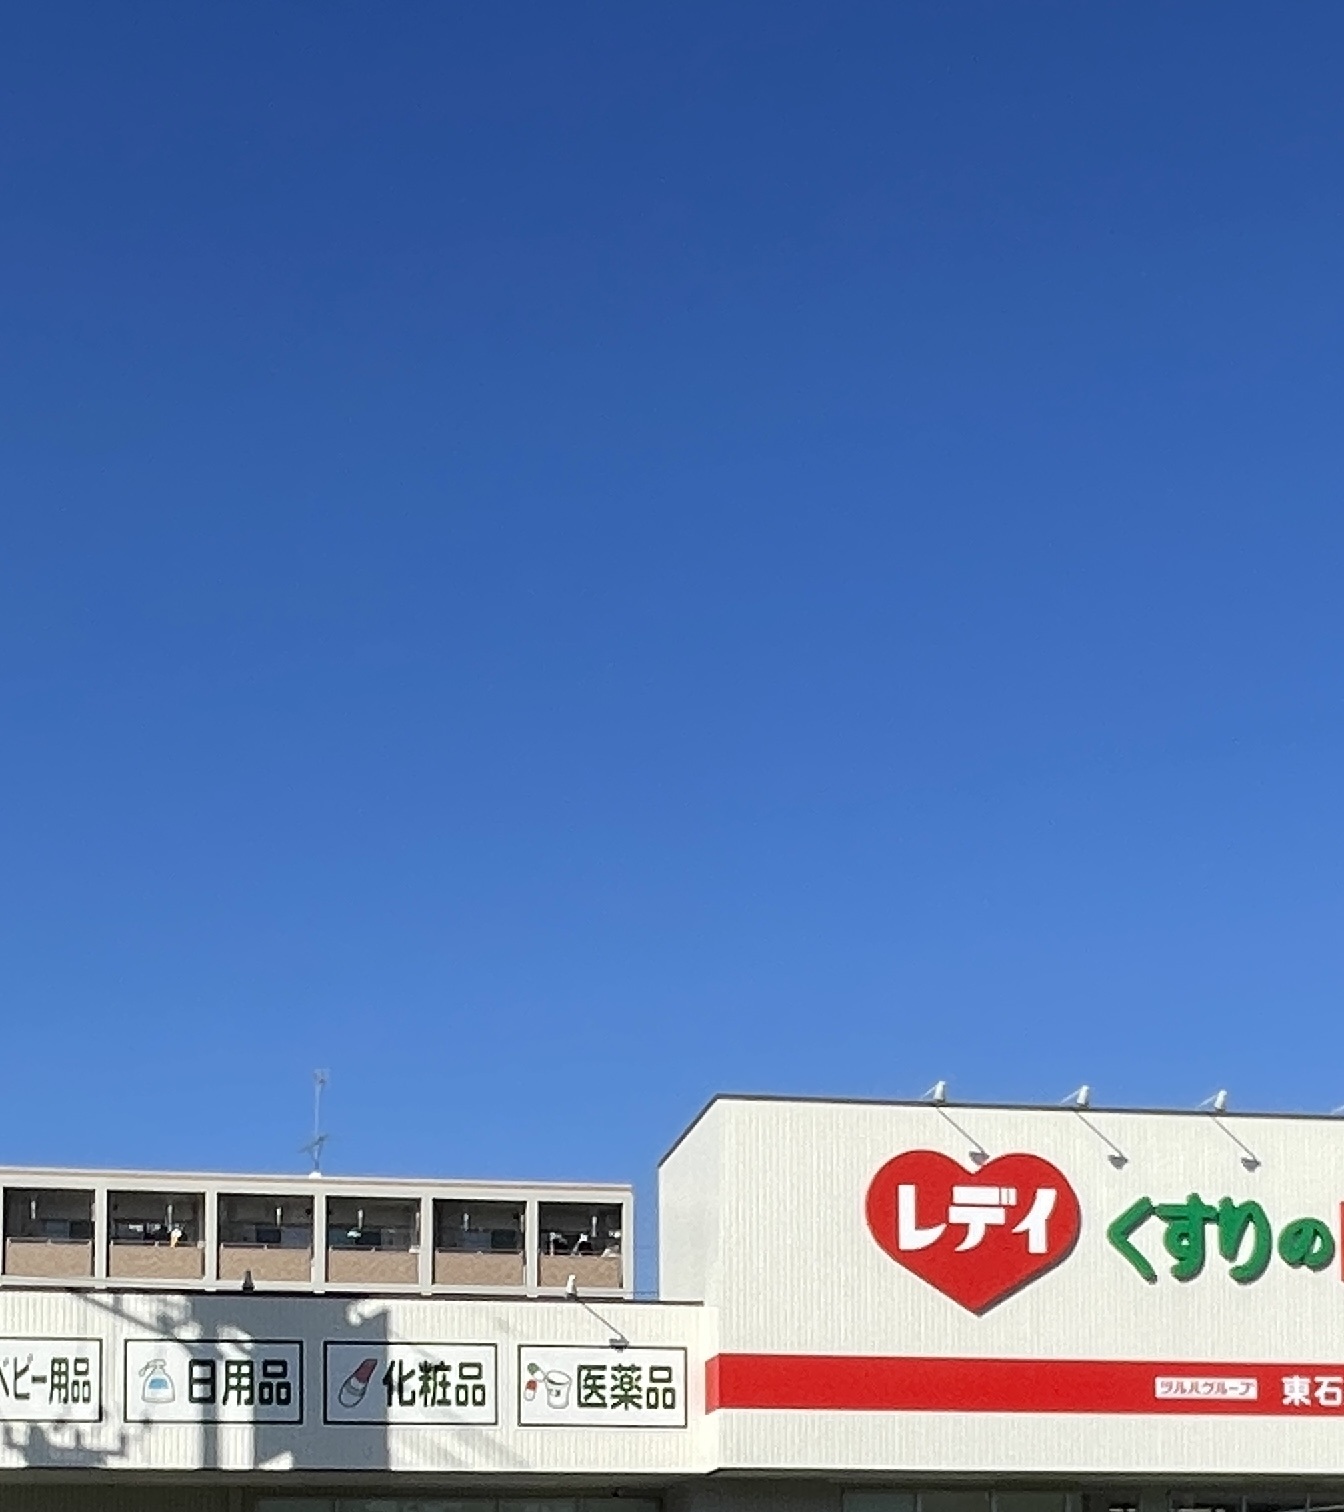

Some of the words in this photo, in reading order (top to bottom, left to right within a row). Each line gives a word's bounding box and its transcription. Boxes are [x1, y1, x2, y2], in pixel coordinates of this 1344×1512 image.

[188, 1358, 292, 1406] 日用品
[382, 1359, 486, 1408] 化粧品
[577, 1363, 676, 1412] 医薬品
